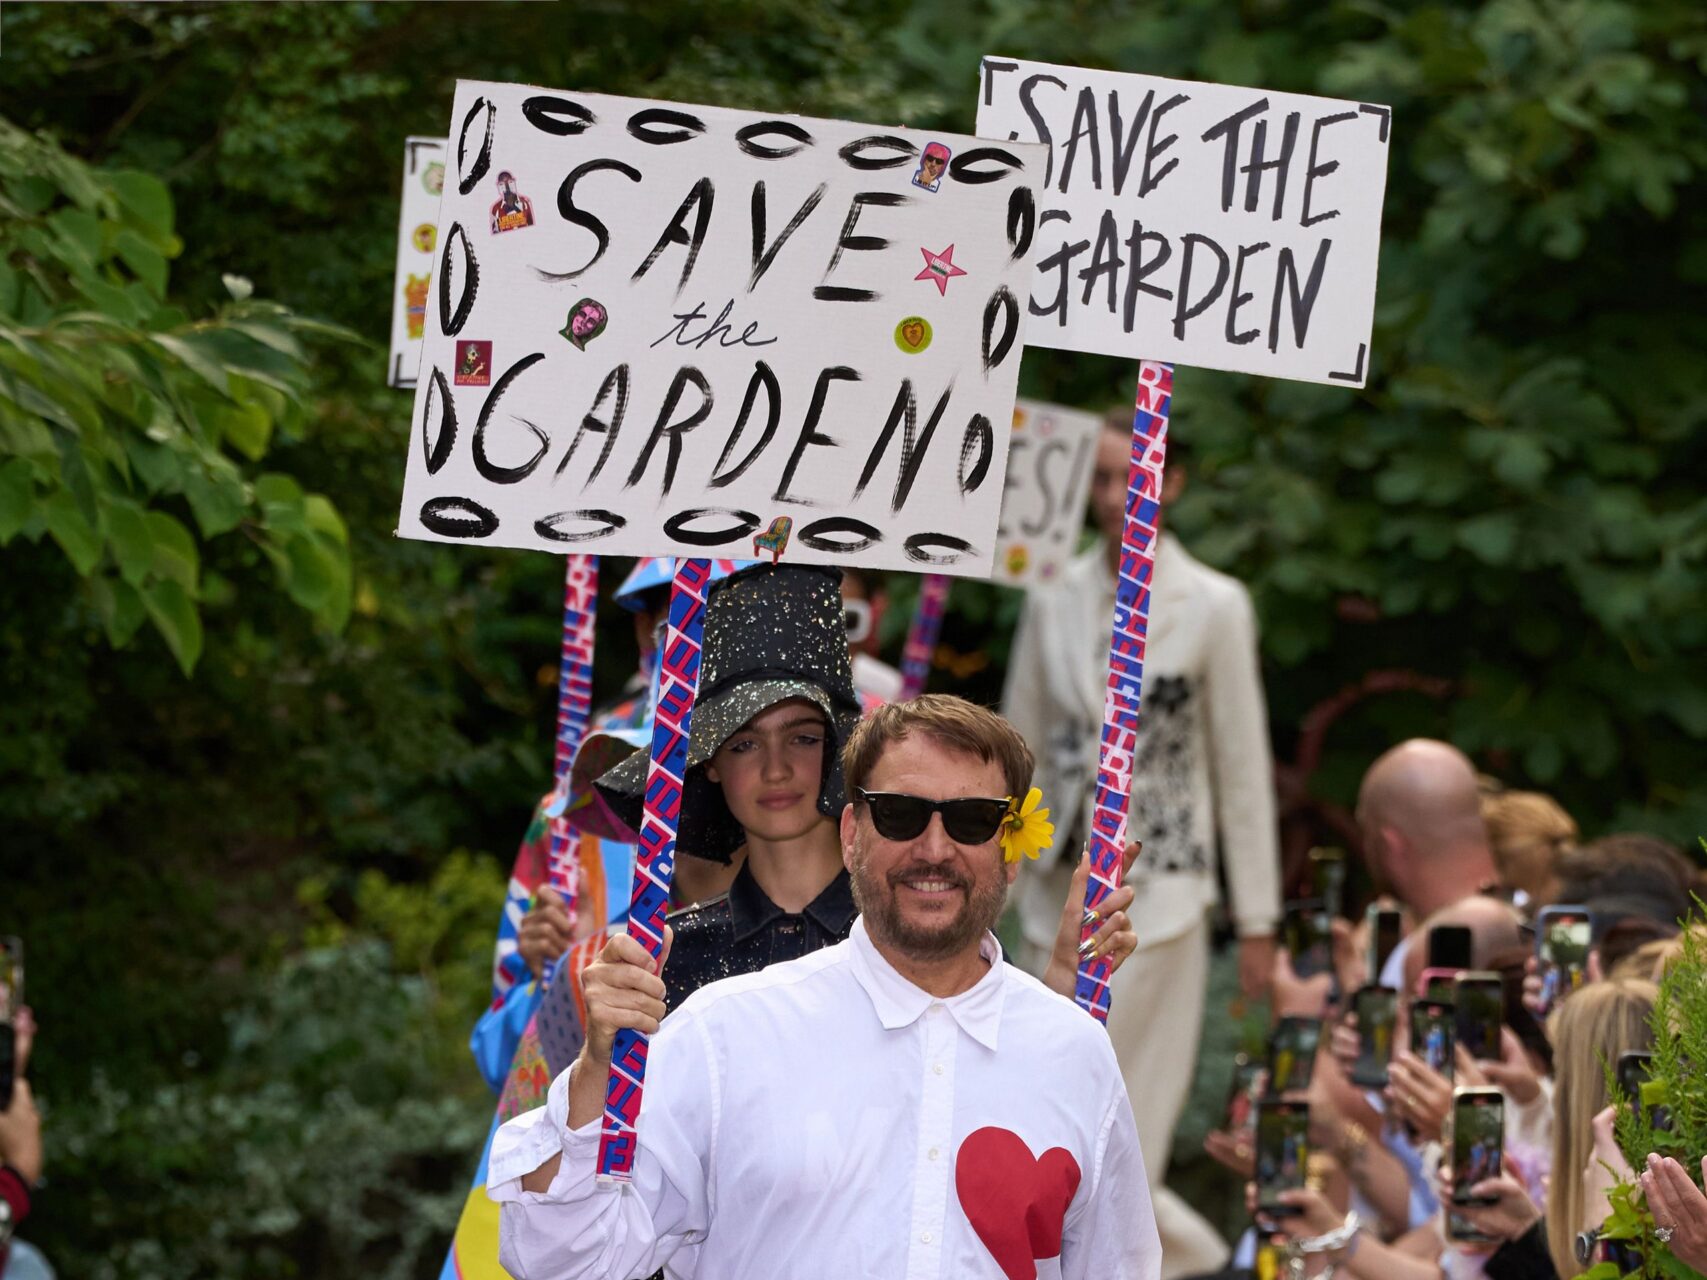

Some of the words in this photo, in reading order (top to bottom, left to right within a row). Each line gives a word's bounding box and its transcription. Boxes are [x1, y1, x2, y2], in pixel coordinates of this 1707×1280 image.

[1009, 74, 1191, 197] SAVE
[1202, 98, 1359, 227] THE
[528, 158, 920, 301] SAVE
[1028, 209, 1332, 354] GARDEN
[651, 298, 777, 349] the
[472, 352, 957, 517] GARDEN
